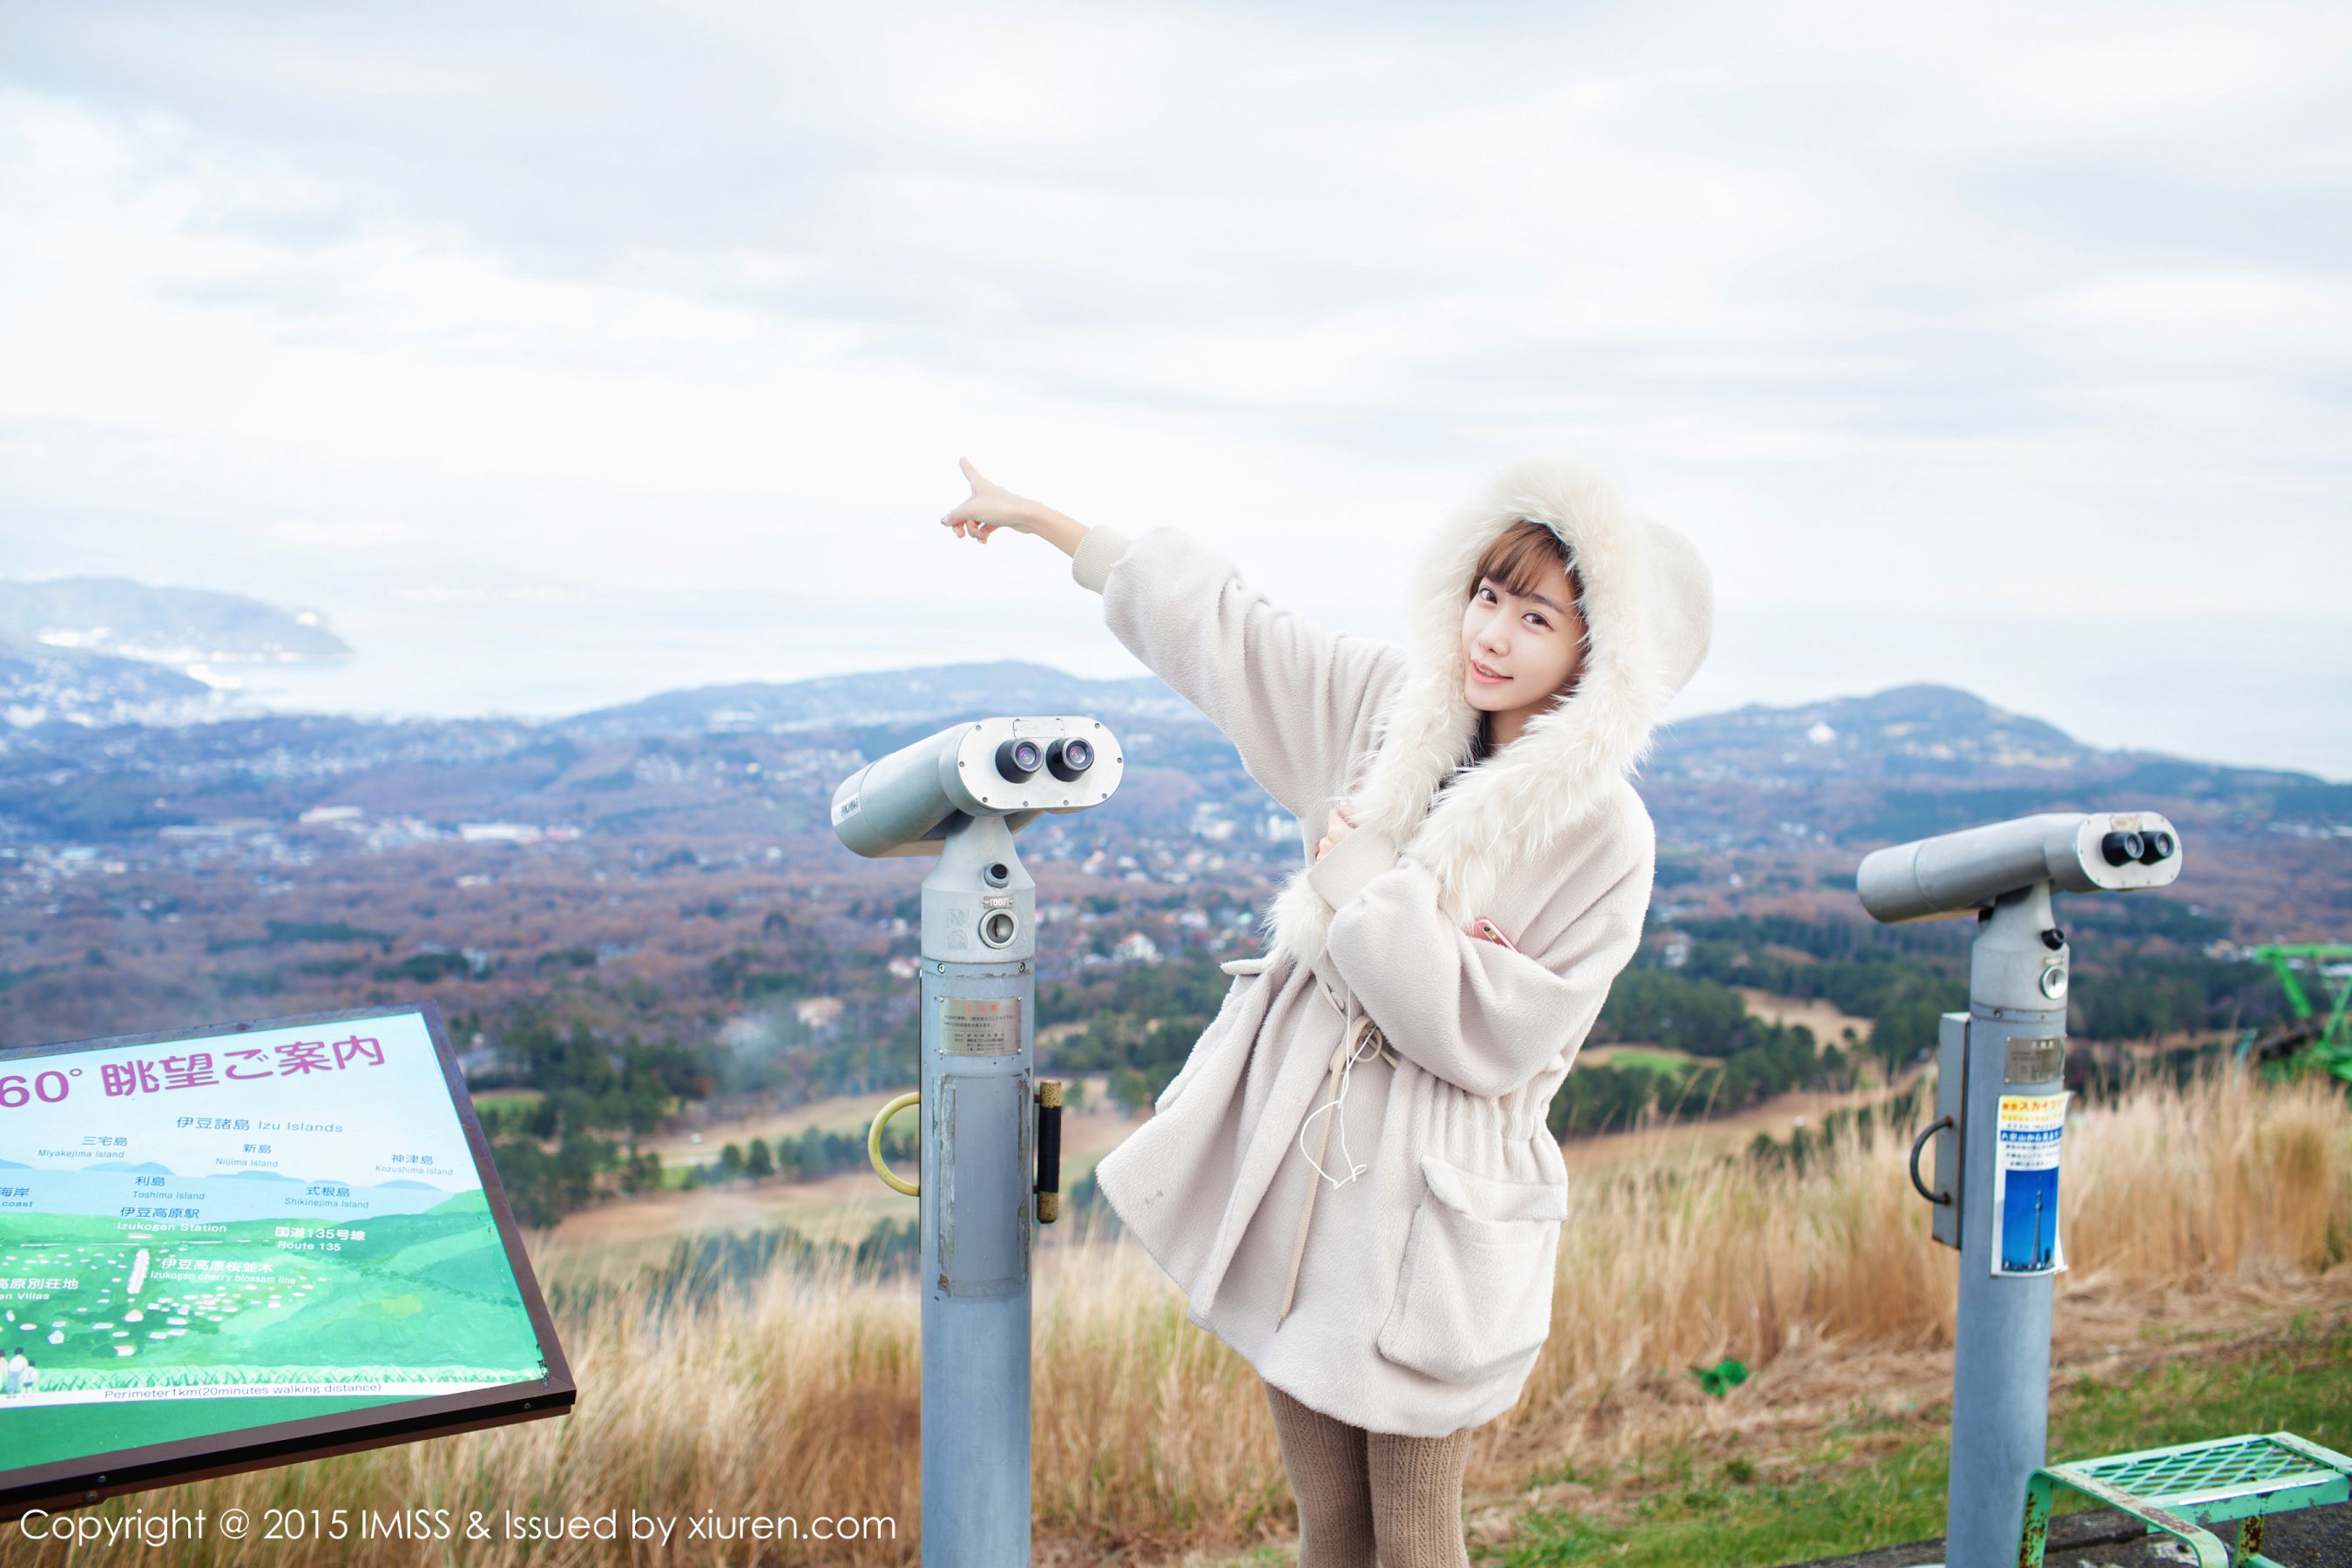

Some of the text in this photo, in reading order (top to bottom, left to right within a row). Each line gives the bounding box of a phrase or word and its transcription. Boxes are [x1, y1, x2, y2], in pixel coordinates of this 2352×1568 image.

[100, 1035, 385, 1098] 眺望ご案内
[176, 1117, 343, 1133] 伊豆諸島 Izu Islands
[82, 1136, 128, 1146] 三宅島
[37, 1149, 125, 1159] Miyakejima Island
[242, 1143, 272, 1154] 新島
[215, 1157, 279, 1168] Niijima Island
[391, 1153, 434, 1165] 神津島
[375, 1164, 454, 1176] Kozushima Island
[134, 1176, 166, 1186] 利島
[132, 1190, 206, 1200] Toshima Island
[306, 1186, 350, 1198] 式根島
[285, 1197, 369, 1209] Shikinejima Island
[120, 1206, 200, 1219] 伊豆高原駅
[117, 1221, 227, 1233] Izukogen Station
[274, 1226, 366, 1241] 国道135号線
[278, 1240, 341, 1252] Route 135
[161, 1258, 274, 1273] 伊豆高原桜並木
[150, 1270, 196, 1281] Izukogen
[198, 1273, 232, 1283] cherry
[278, 1274, 296, 1284] line
[273, 1383, 321, 1395] walking
[324, 1382, 382, 1394] distance)
